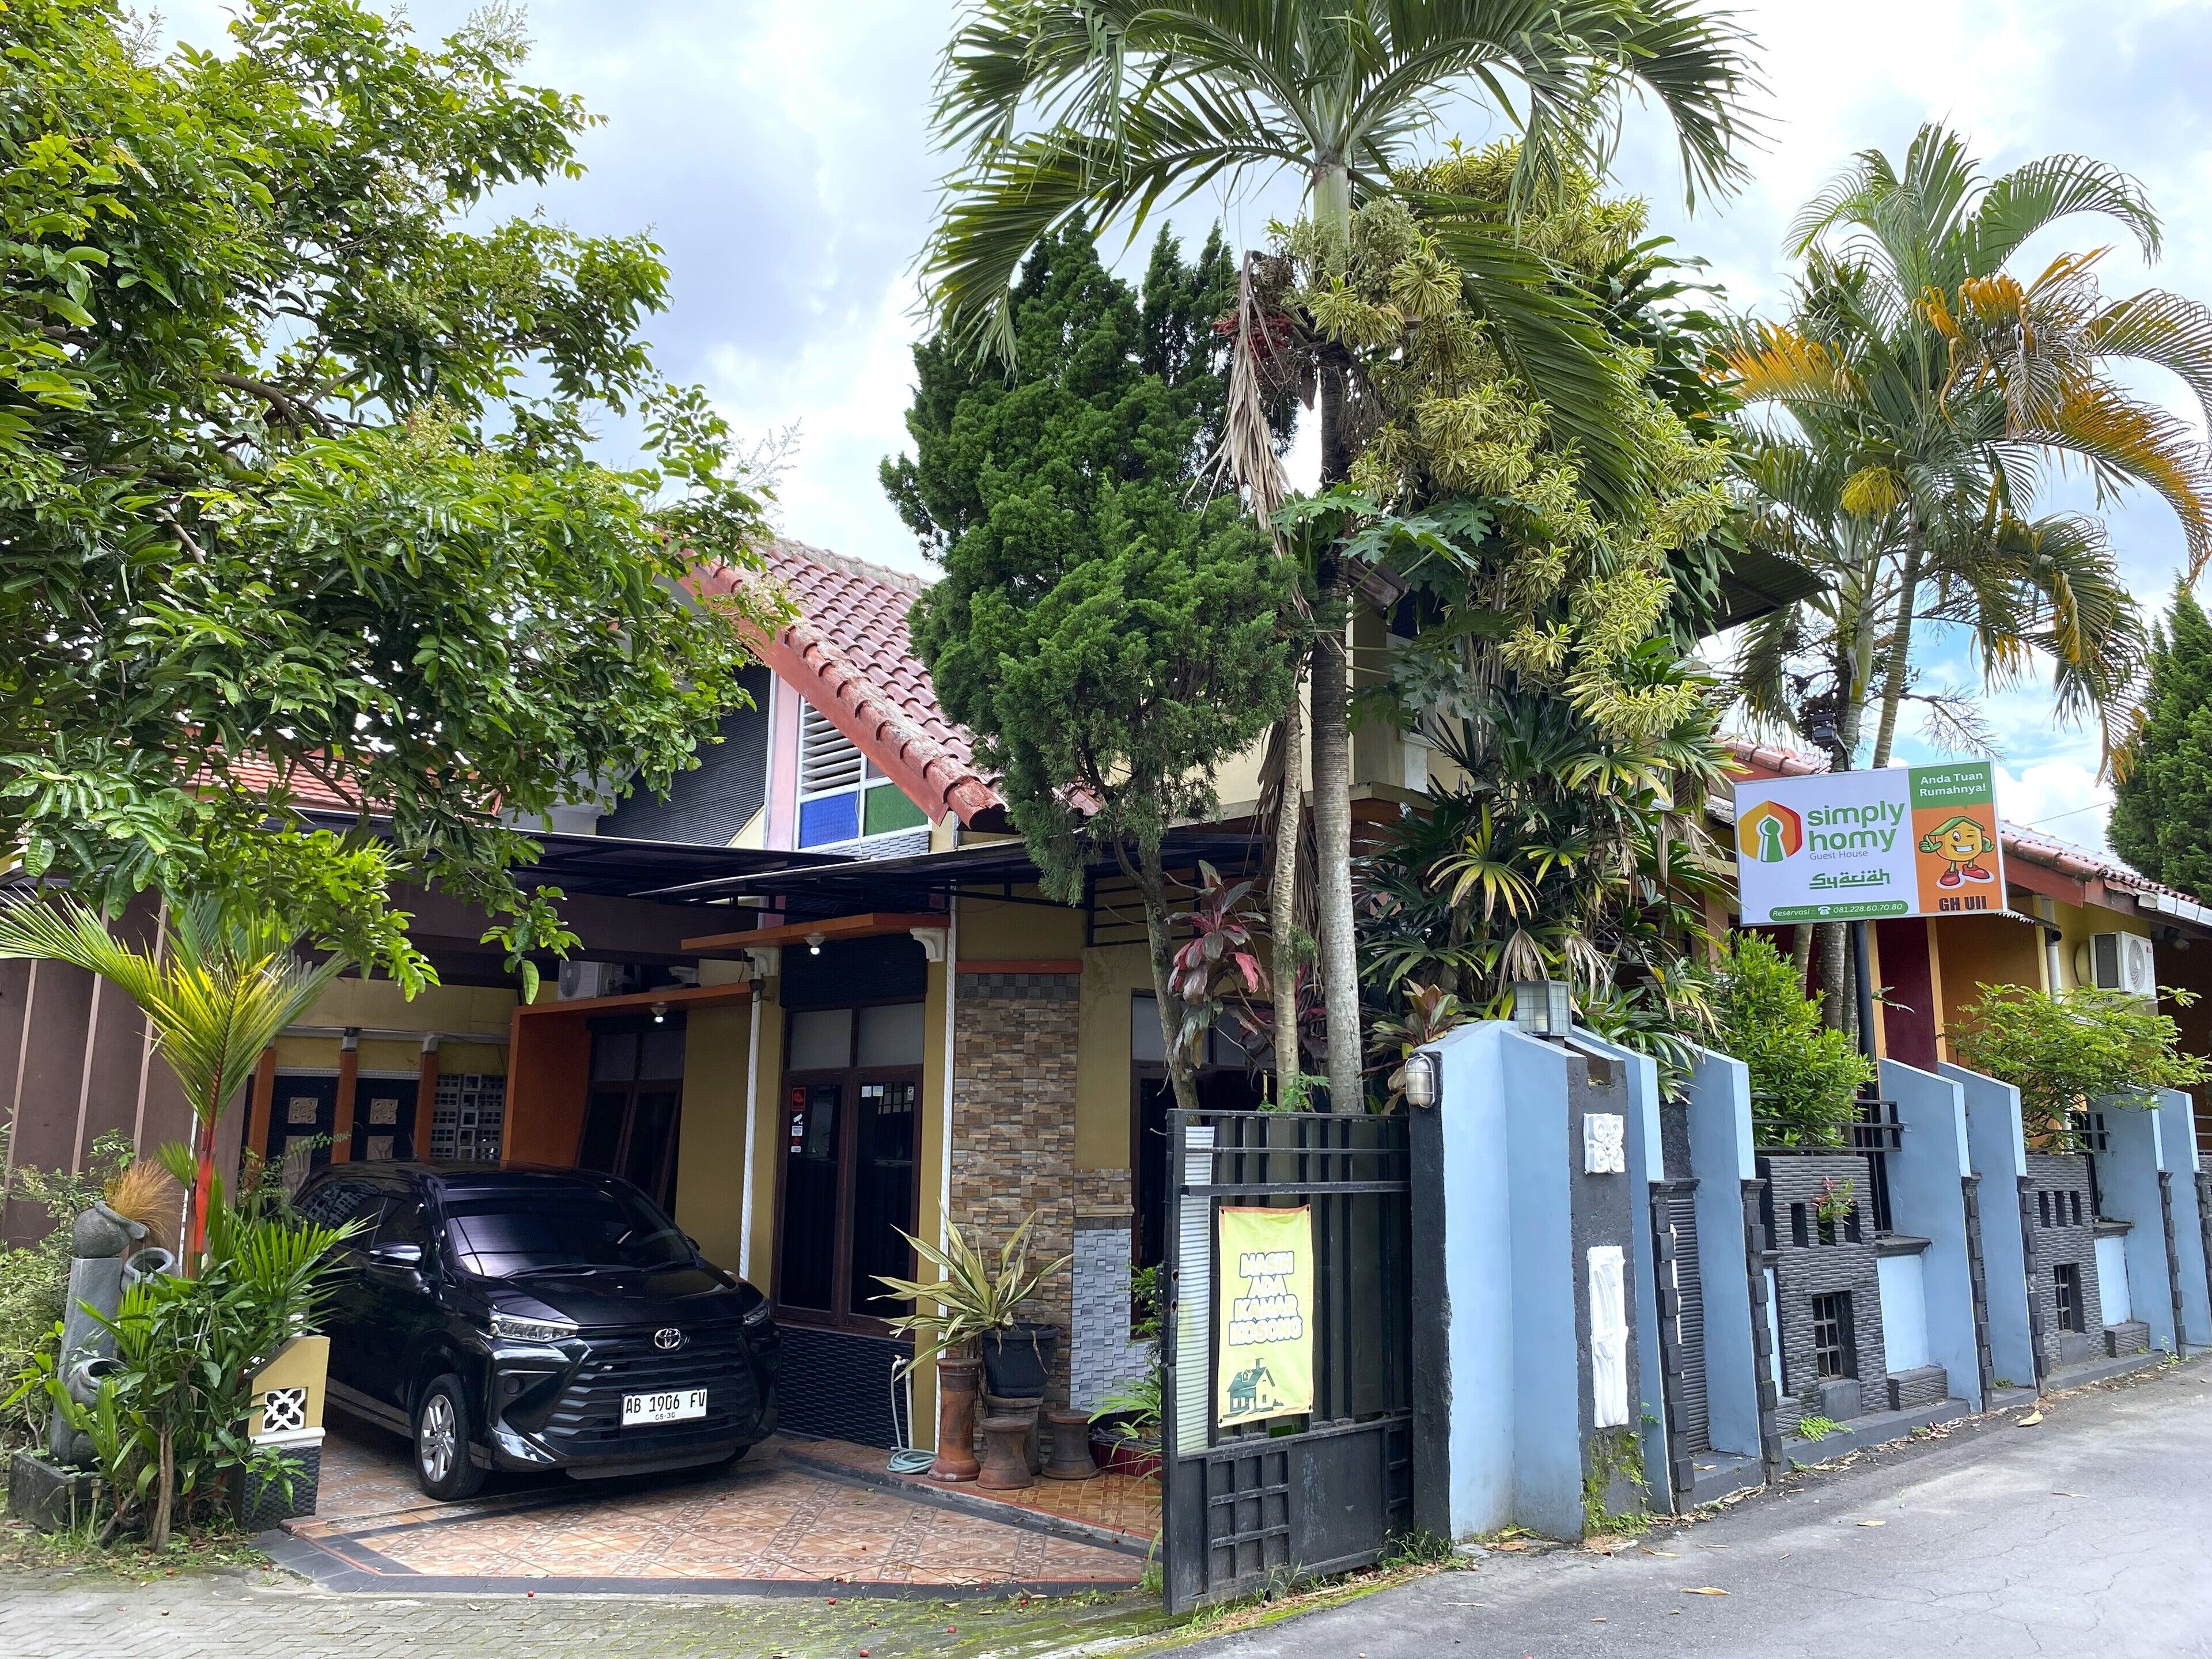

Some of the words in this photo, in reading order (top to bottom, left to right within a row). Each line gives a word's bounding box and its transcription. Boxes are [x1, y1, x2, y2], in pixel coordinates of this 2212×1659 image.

[1921, 775, 1951, 785] Anda
[1953, 772, 1983, 782] Tuan
[1919, 783, 1986, 797] Rumahnya!
[1807, 800, 1905, 828] simply
[1809, 828, 1896, 853] homy
[1809, 852, 1836, 860] Guest
[1839, 850, 1868, 858] House
[1833, 903, 1903, 914] 081.228.60.70.80
[1939, 897, 1961, 911] GH
[1964, 896, 1987, 910] UII
[1239, 1251, 1294, 1278] MASIH
[1247, 1275, 1288, 1298] ADA
[1233, 1294, 1298, 1321] KAMAR
[1229, 1315, 1302, 1346] KOSONG
[626, 1397, 641, 1413] AB
[649, 1395, 680, 1412] 1906
[690, 1391, 706, 1408] FV
